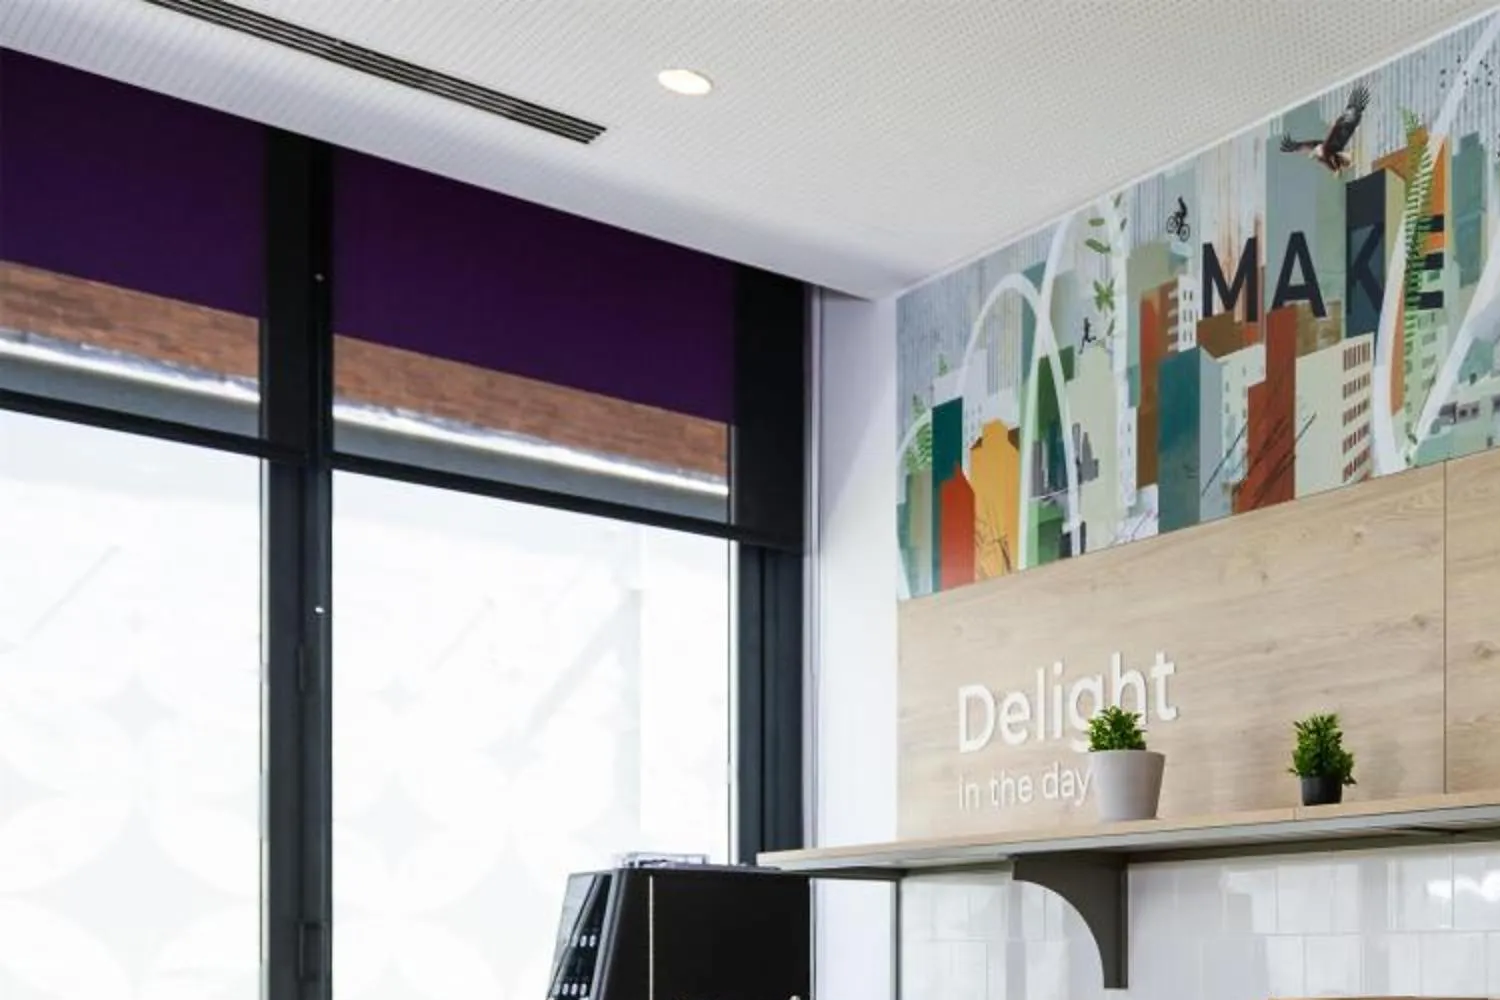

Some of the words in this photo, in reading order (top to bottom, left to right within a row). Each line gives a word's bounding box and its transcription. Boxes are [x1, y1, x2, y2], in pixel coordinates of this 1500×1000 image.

[958, 650, 1178, 752] Delight
[958, 775, 980, 810] in
[990, 769, 1033, 806] the
[1041, 760, 1092, 807] day
